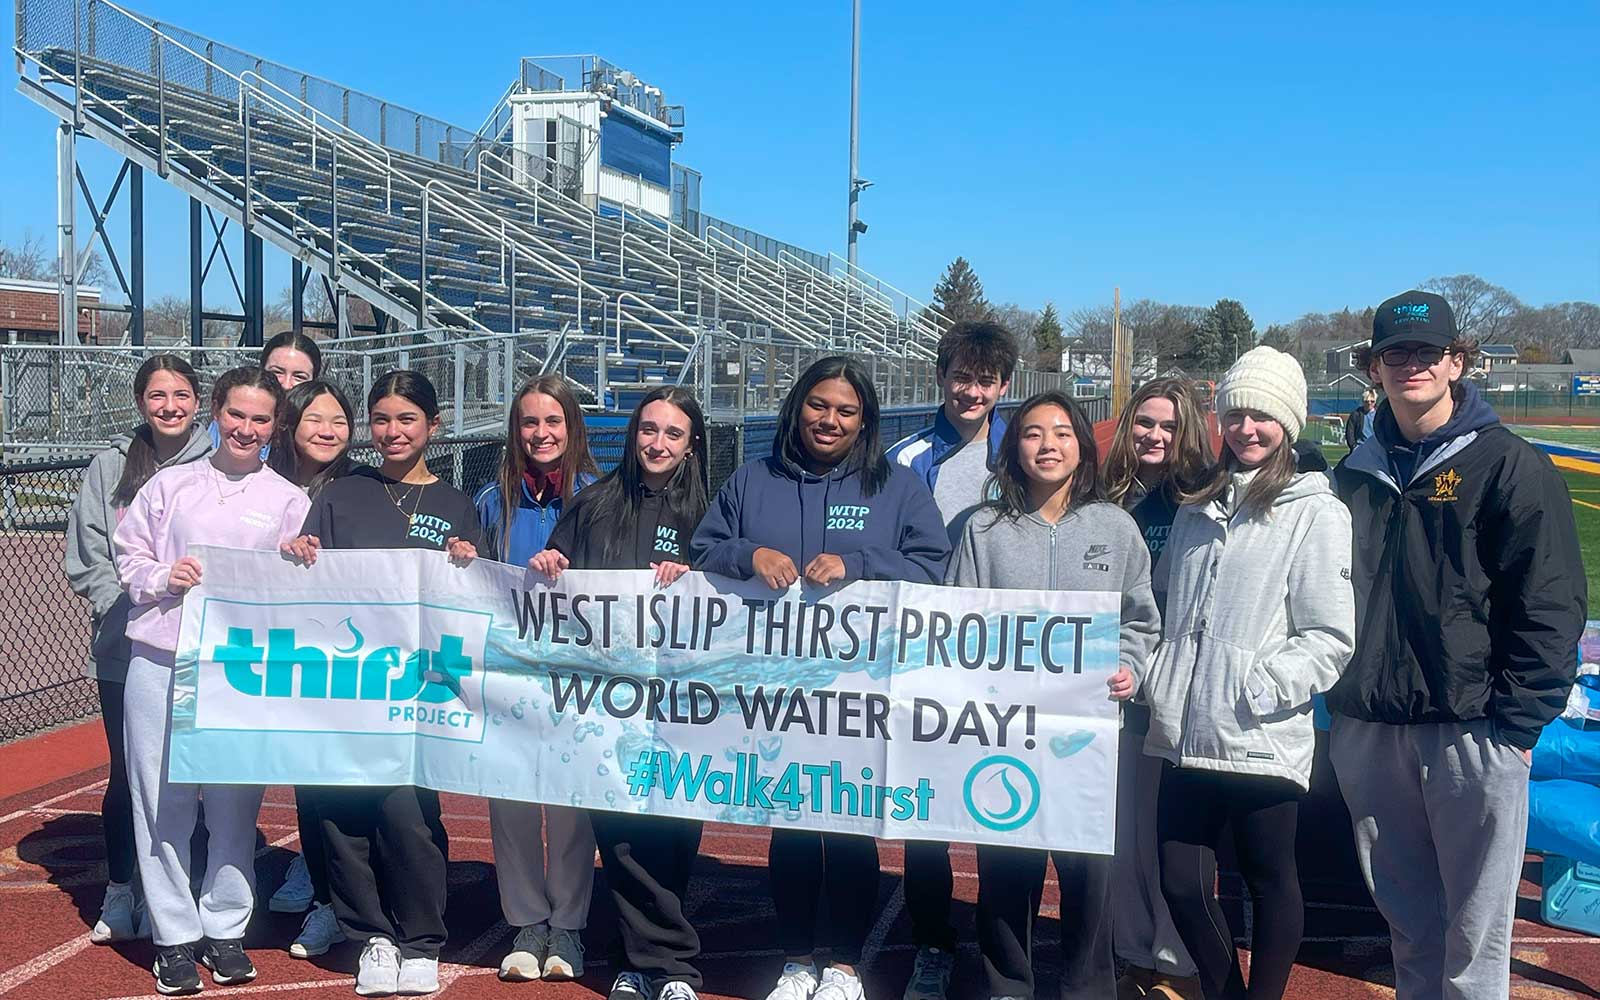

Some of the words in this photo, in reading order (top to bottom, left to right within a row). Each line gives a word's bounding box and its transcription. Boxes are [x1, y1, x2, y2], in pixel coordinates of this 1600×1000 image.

[829, 505, 870, 517] WITP
[411, 513, 452, 532] WITP
[826, 517, 865, 531] 2024
[1144, 525, 1172, 537] WIT
[409, 525, 445, 546] 2024
[657, 525, 678, 540] WI
[654, 539, 680, 555] 202
[1088, 544, 1108, 553] NIKE
[511, 588, 619, 649] WEST
[636, 593, 728, 651] ISLIP
[743, 598, 888, 662] THIRST
[897, 607, 1092, 674] PROJECT
[213, 622, 472, 703] thirst
[388, 706, 474, 729] PROJECT
[549, 671, 720, 725] WORLD
[734, 685, 893, 741] WATER
[911, 697, 1037, 750] DAY!
[626, 750, 935, 821] #Walk4Thirst
